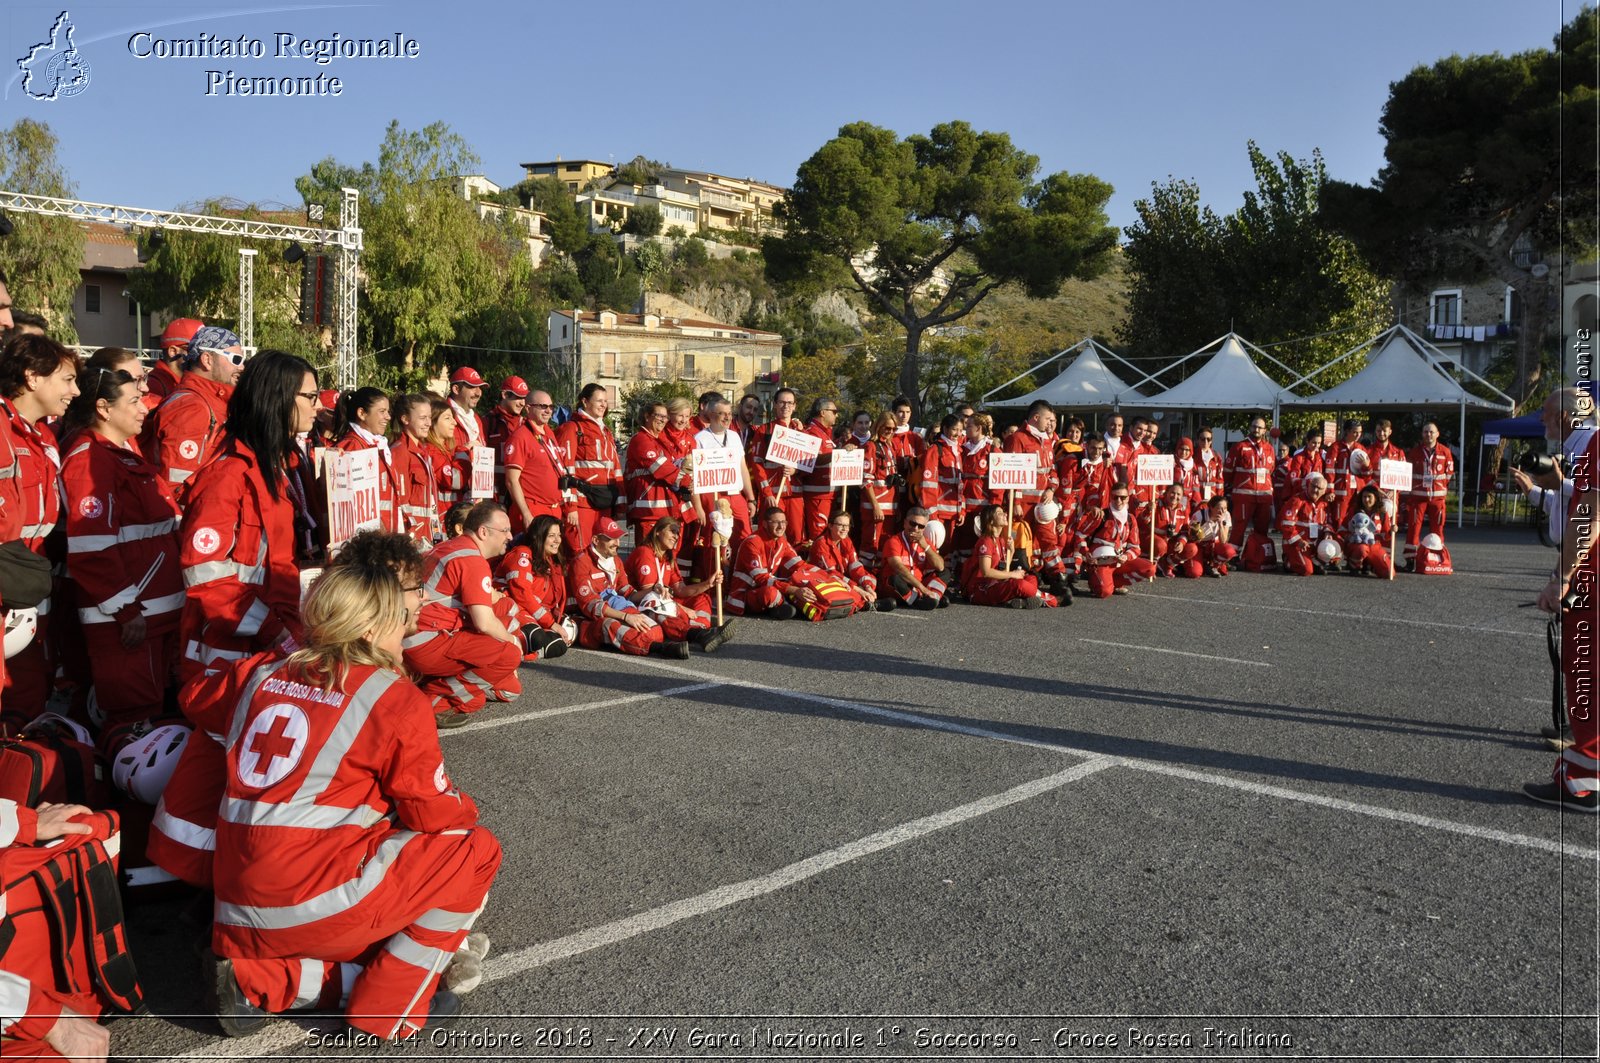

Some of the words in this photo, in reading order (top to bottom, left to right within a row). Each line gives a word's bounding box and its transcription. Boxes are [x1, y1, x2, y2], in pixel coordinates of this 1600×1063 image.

[770, 442, 815, 468] PIEMONTE
[697, 467, 736, 487] ABRUZZO
[992, 469, 1027, 484] SICILIA
[1140, 469, 1171, 481] TOSCANA
[1382, 473, 1410, 486] CAMPANIA
[332, 500, 355, 543] LAZIO
[262, 678, 287, 696] CROCE
[284, 682, 312, 699] ROSSA
